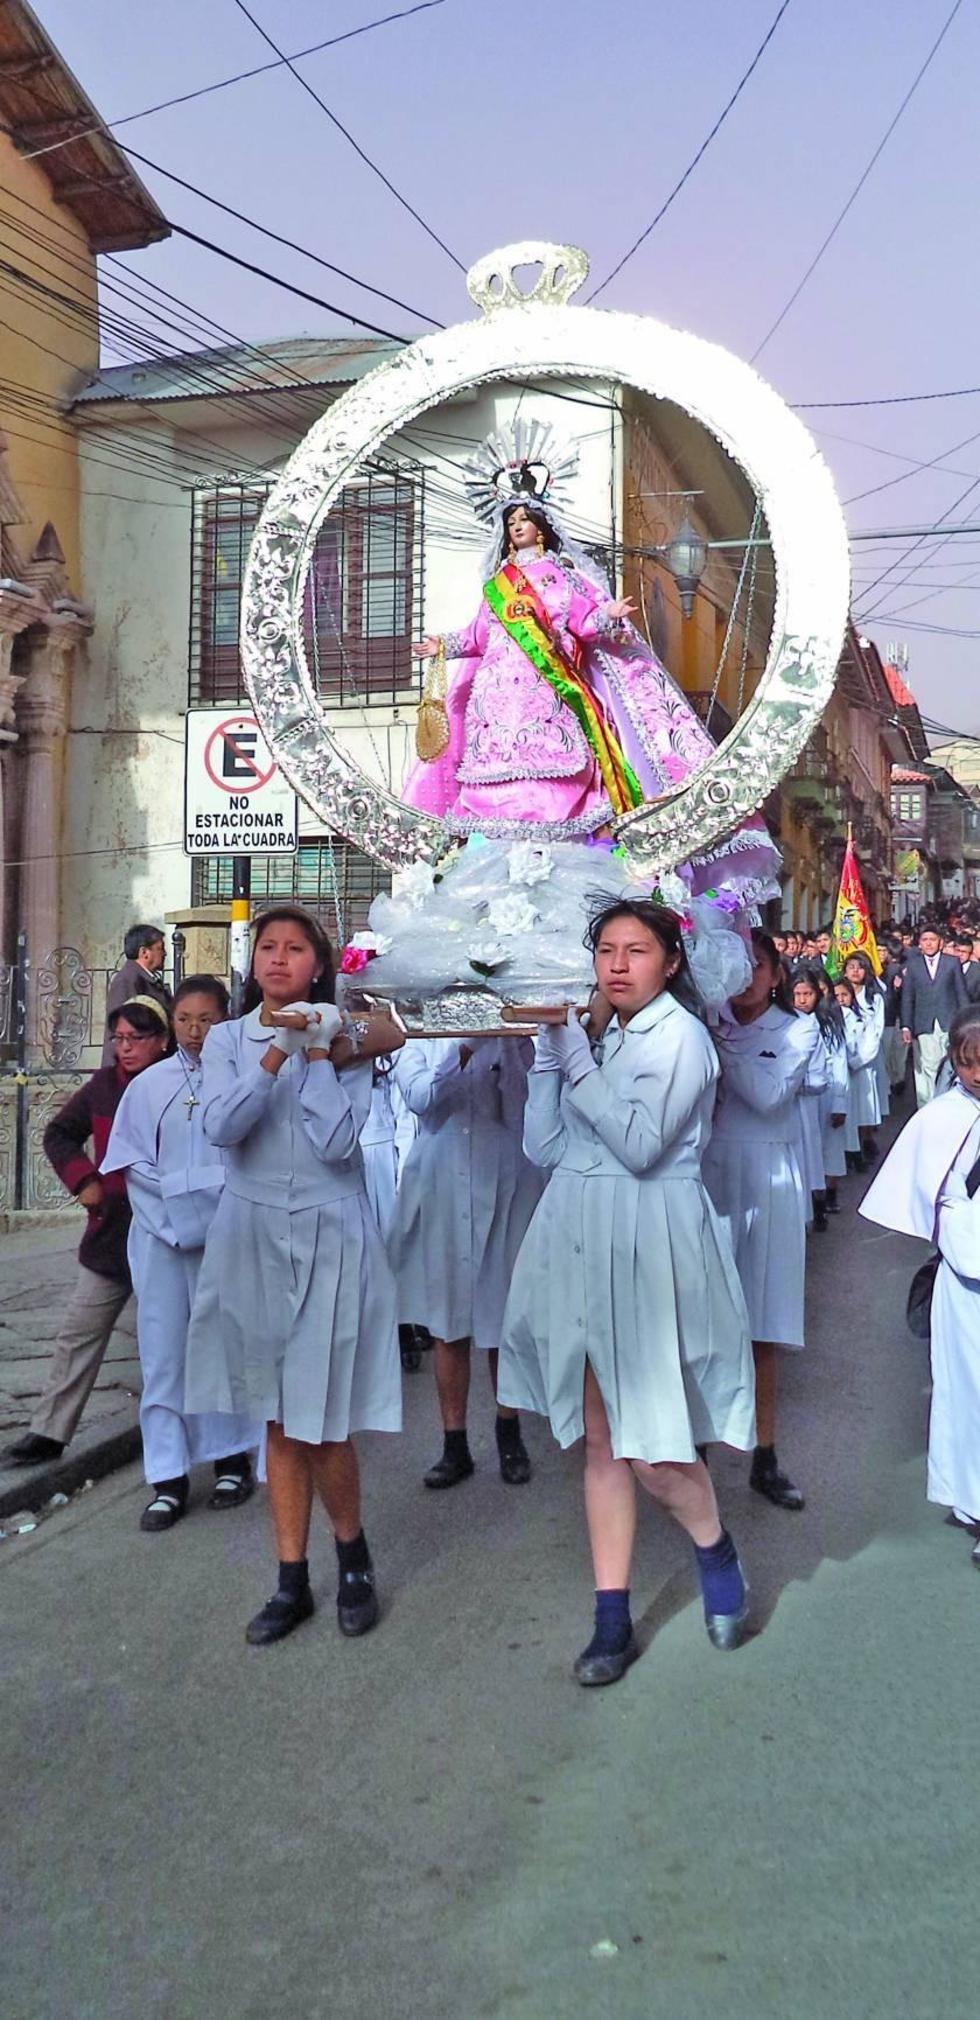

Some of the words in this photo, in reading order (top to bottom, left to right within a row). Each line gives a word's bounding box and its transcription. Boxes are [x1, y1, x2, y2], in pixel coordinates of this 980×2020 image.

[223, 733, 257, 777] E
[229, 796, 249, 810] NO
[195, 813, 284, 828] ESTACIONAR
[188, 833, 219, 847] TODA
[223, 833, 238, 847] LA
[243, 832, 295, 847] CUADRA
